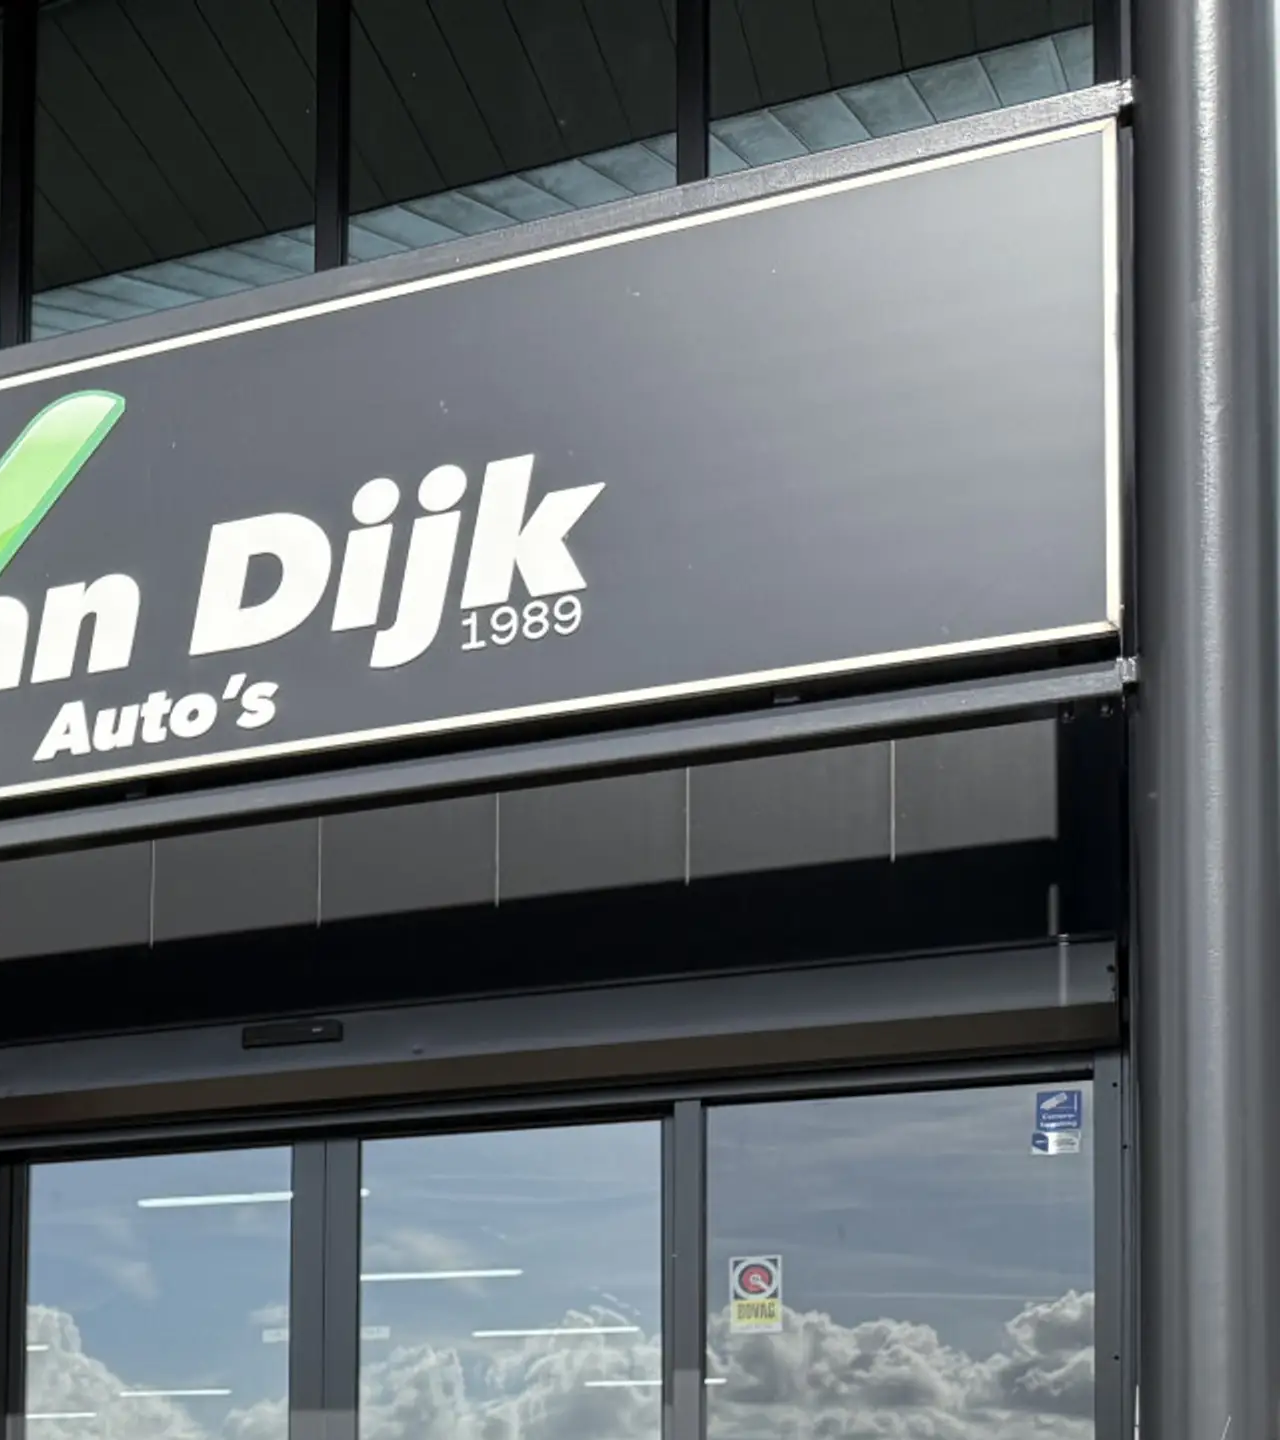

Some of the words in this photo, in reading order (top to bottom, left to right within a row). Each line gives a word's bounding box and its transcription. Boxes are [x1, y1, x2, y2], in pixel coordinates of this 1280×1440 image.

[190, 454, 606, 669] Dijk
[458, 595, 584, 652] 1989
[33, 674, 278, 762] Auto's
[736, 1301, 776, 1320] BOVAG
